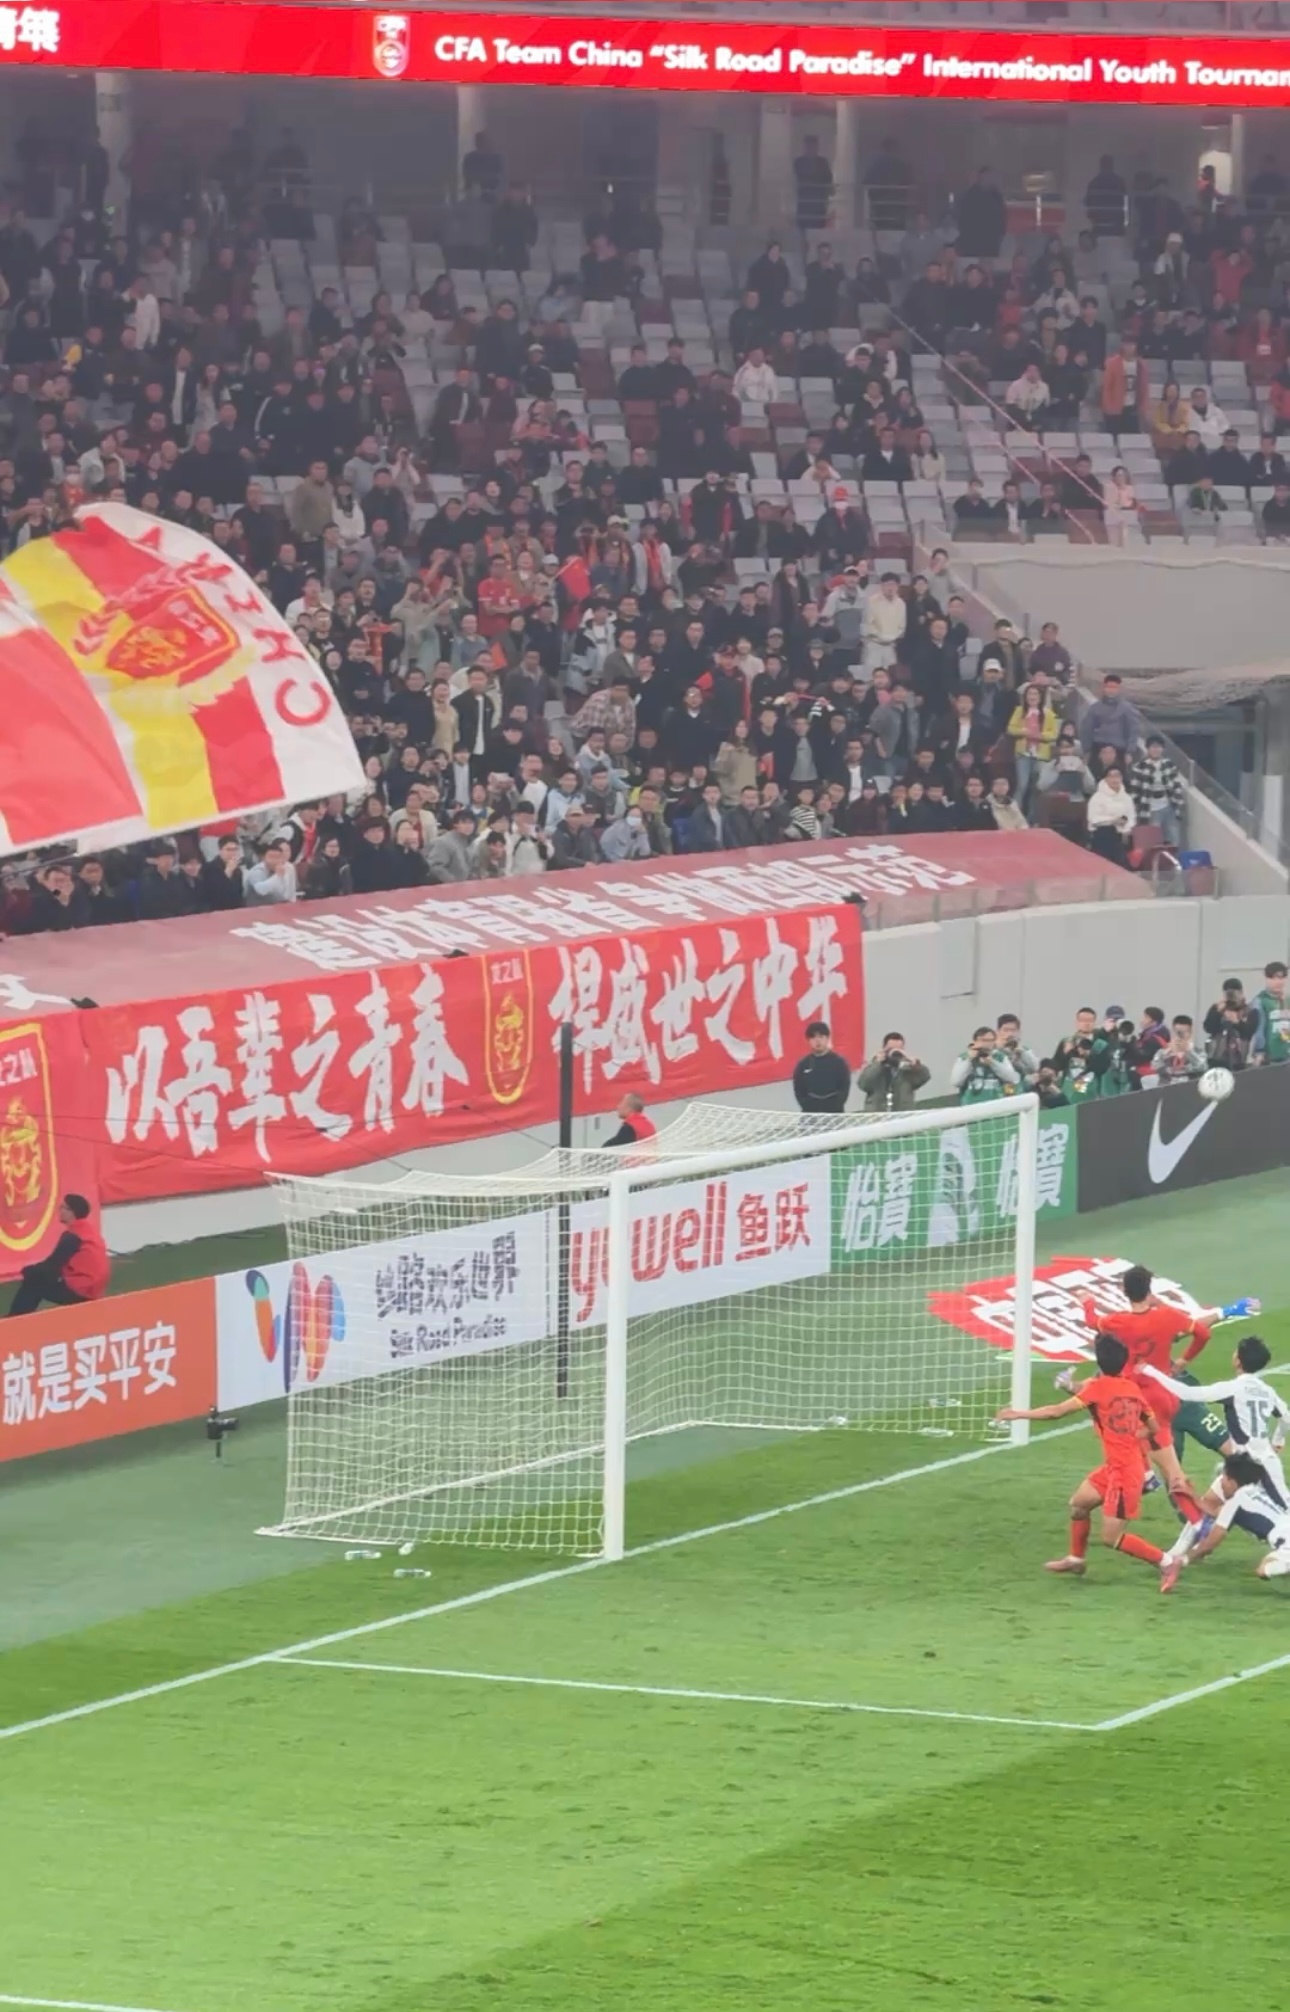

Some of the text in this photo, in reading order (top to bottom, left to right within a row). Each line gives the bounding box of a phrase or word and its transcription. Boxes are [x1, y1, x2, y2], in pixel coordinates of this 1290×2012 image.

[434, 36, 488, 63] CFA
[493, 38, 562, 65] Team
[568, 41, 643, 68] China
[714, 46, 782, 73] Road
[923, 53, 1093, 82] International
[1099, 59, 1177, 84] Youth
[105, 962, 468, 1162] 以吾辈之青春
[735, 1183, 811, 1262] 鱼跃
[2, 1321, 177, 1425] 就是买平安
